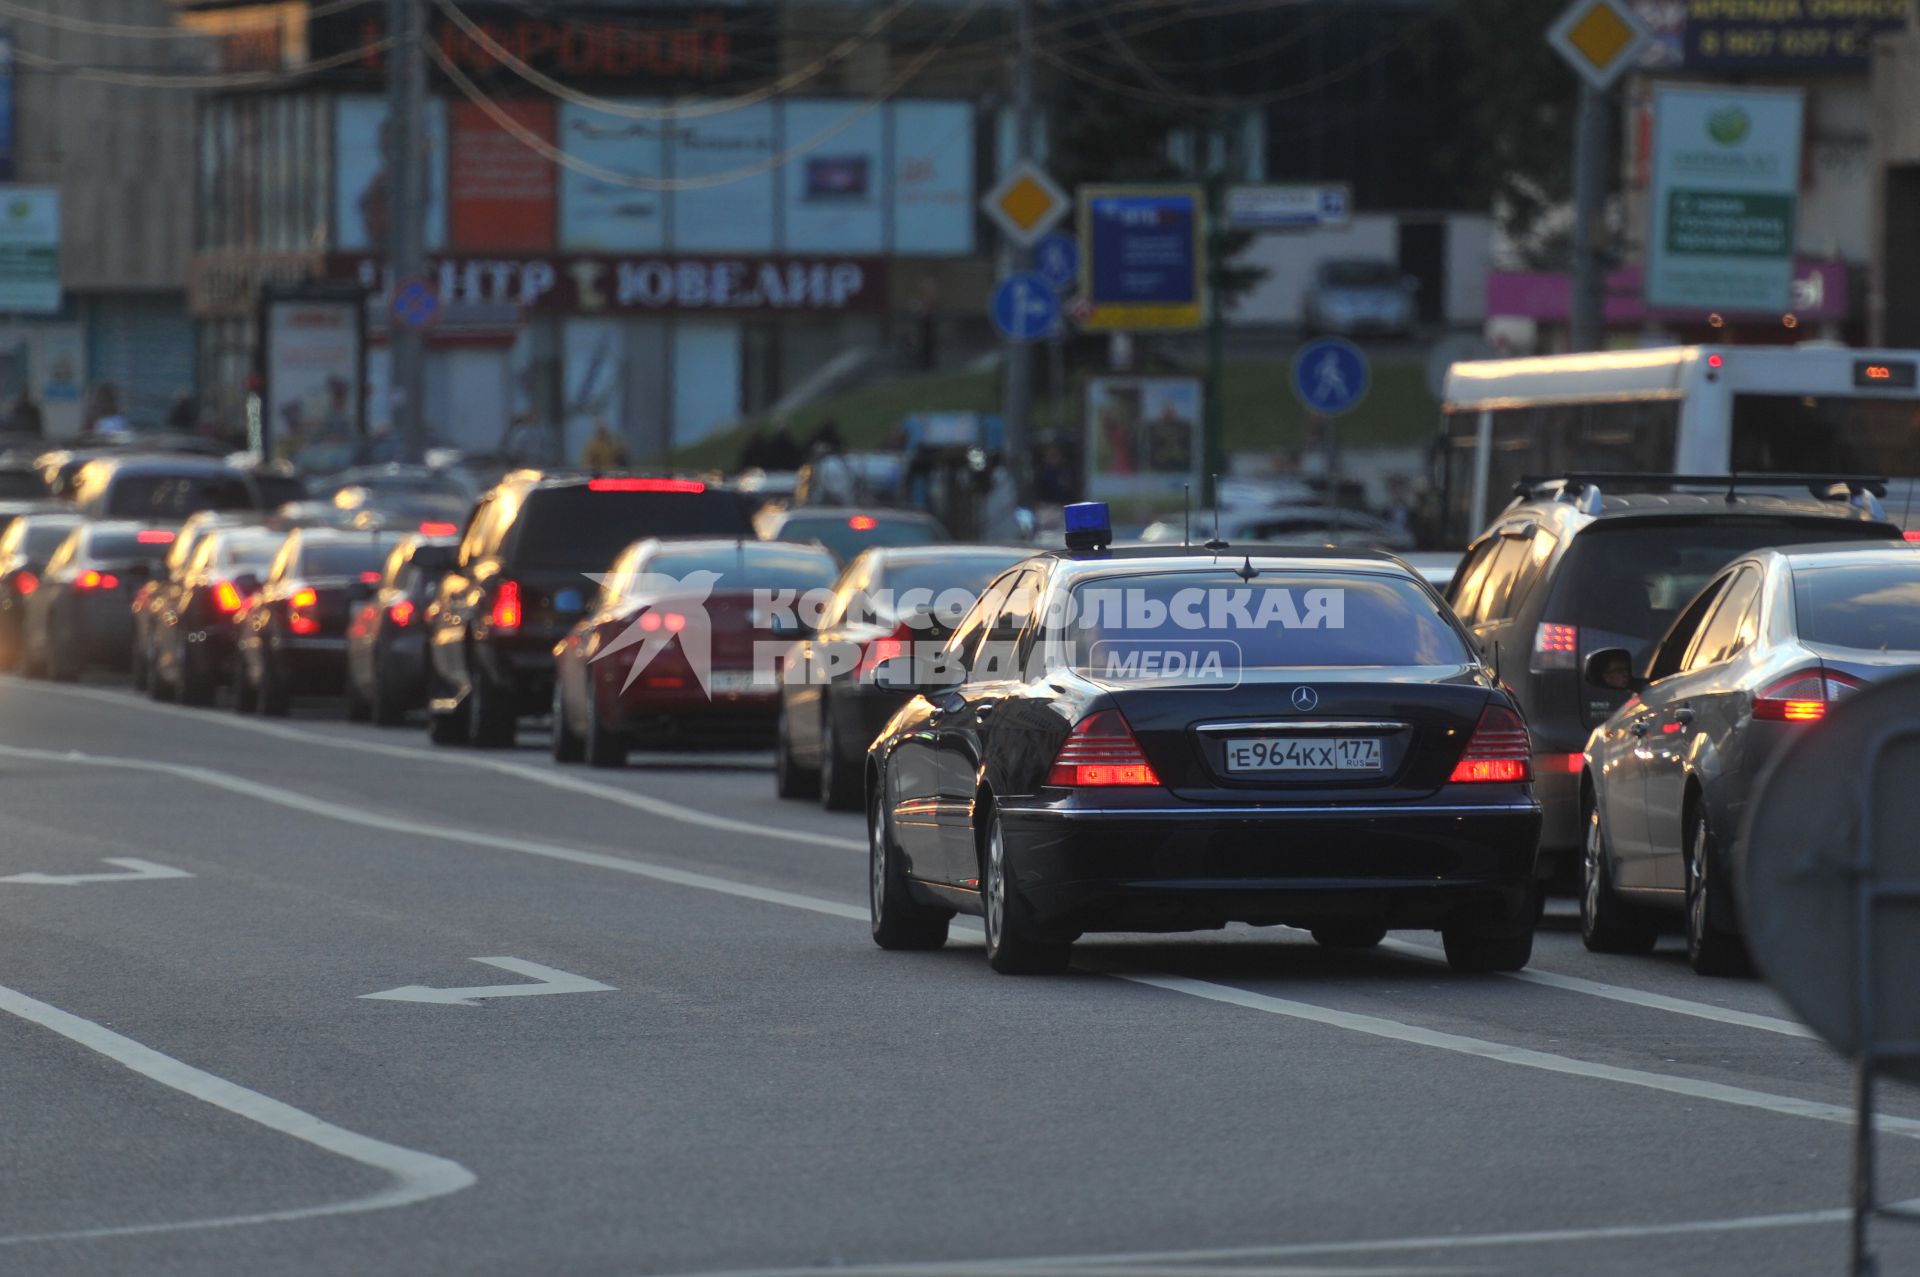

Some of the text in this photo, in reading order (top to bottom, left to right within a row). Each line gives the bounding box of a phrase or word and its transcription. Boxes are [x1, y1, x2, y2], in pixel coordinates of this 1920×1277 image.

[356, 258, 556, 306] ЦНТР
[616, 259, 865, 307] ЮВЕЛИР
[1338, 740, 1374, 759] 177
[1346, 759, 1365, 767] RUS
